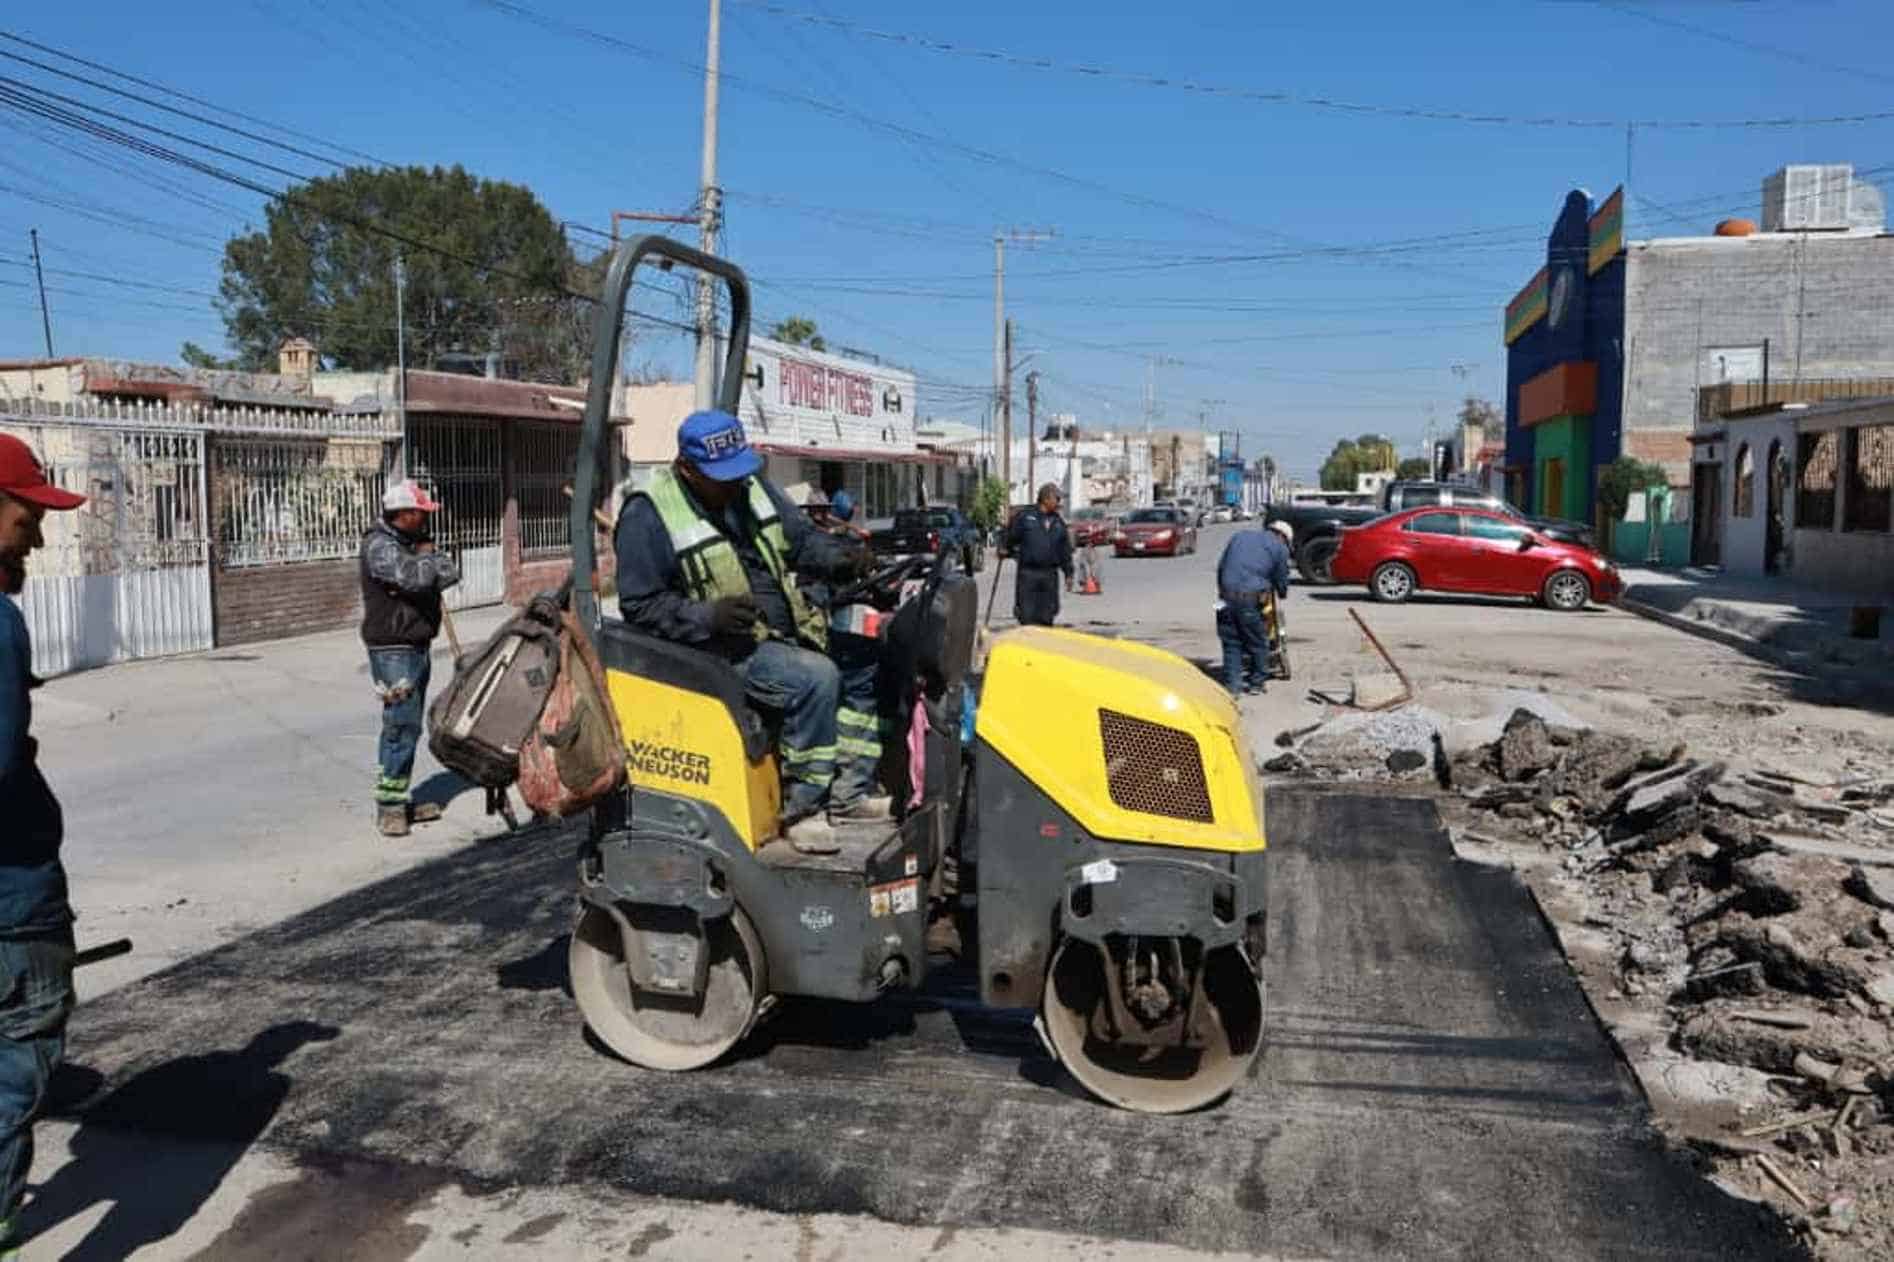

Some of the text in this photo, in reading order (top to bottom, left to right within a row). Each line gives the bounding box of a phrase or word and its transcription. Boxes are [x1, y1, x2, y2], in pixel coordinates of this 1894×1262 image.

[779, 358, 874, 418] POWER FITNESS
[627, 752, 710, 785] NEUSON
[630, 739, 711, 769] WACKER
